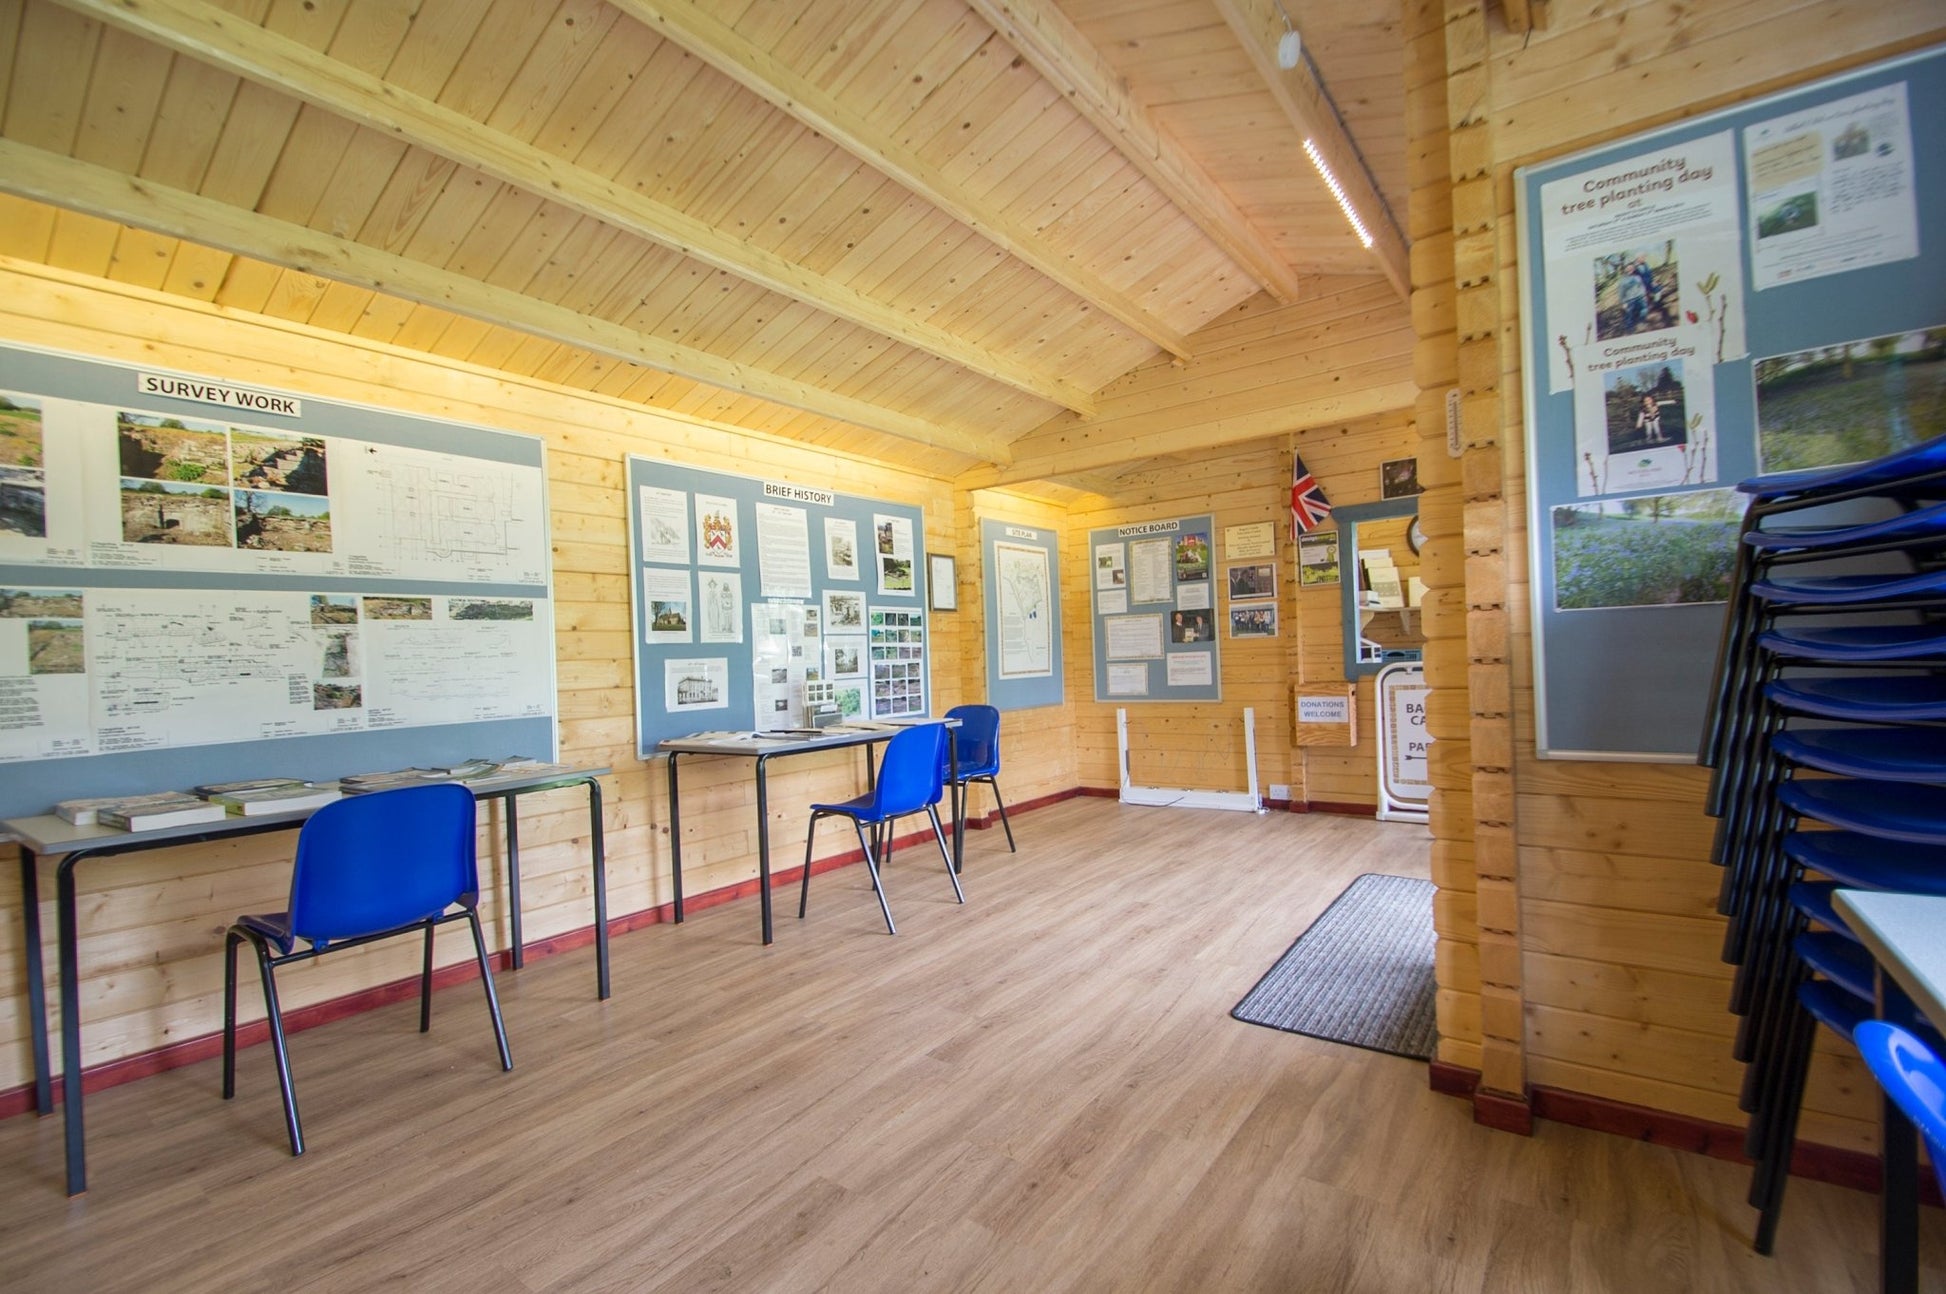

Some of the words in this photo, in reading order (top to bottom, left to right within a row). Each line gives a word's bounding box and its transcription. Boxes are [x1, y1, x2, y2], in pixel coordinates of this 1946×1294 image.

[1583, 157, 1686, 193] Community
[1561, 198, 1596, 215] tree
[1600, 176, 1674, 208] planting
[1678, 166, 1713, 184] day
[1627, 198, 1642, 209] at
[1604, 337, 1677, 357] Community
[1588, 361, 1613, 372] tree
[1615, 351, 1668, 369] planting
[1671, 346, 1695, 357] day
[146, 377, 230, 403] SURVEY
[235, 391, 295, 414] WORK
[765, 484, 792, 497] BRIEF
[794, 489, 832, 504] HISTORY
[1119, 525, 1147, 536] NOTICE
[1149, 522, 1178, 533] BOARD
[1304, 710, 1342, 718] WELCOME
[1406, 703, 1424, 714] BA
